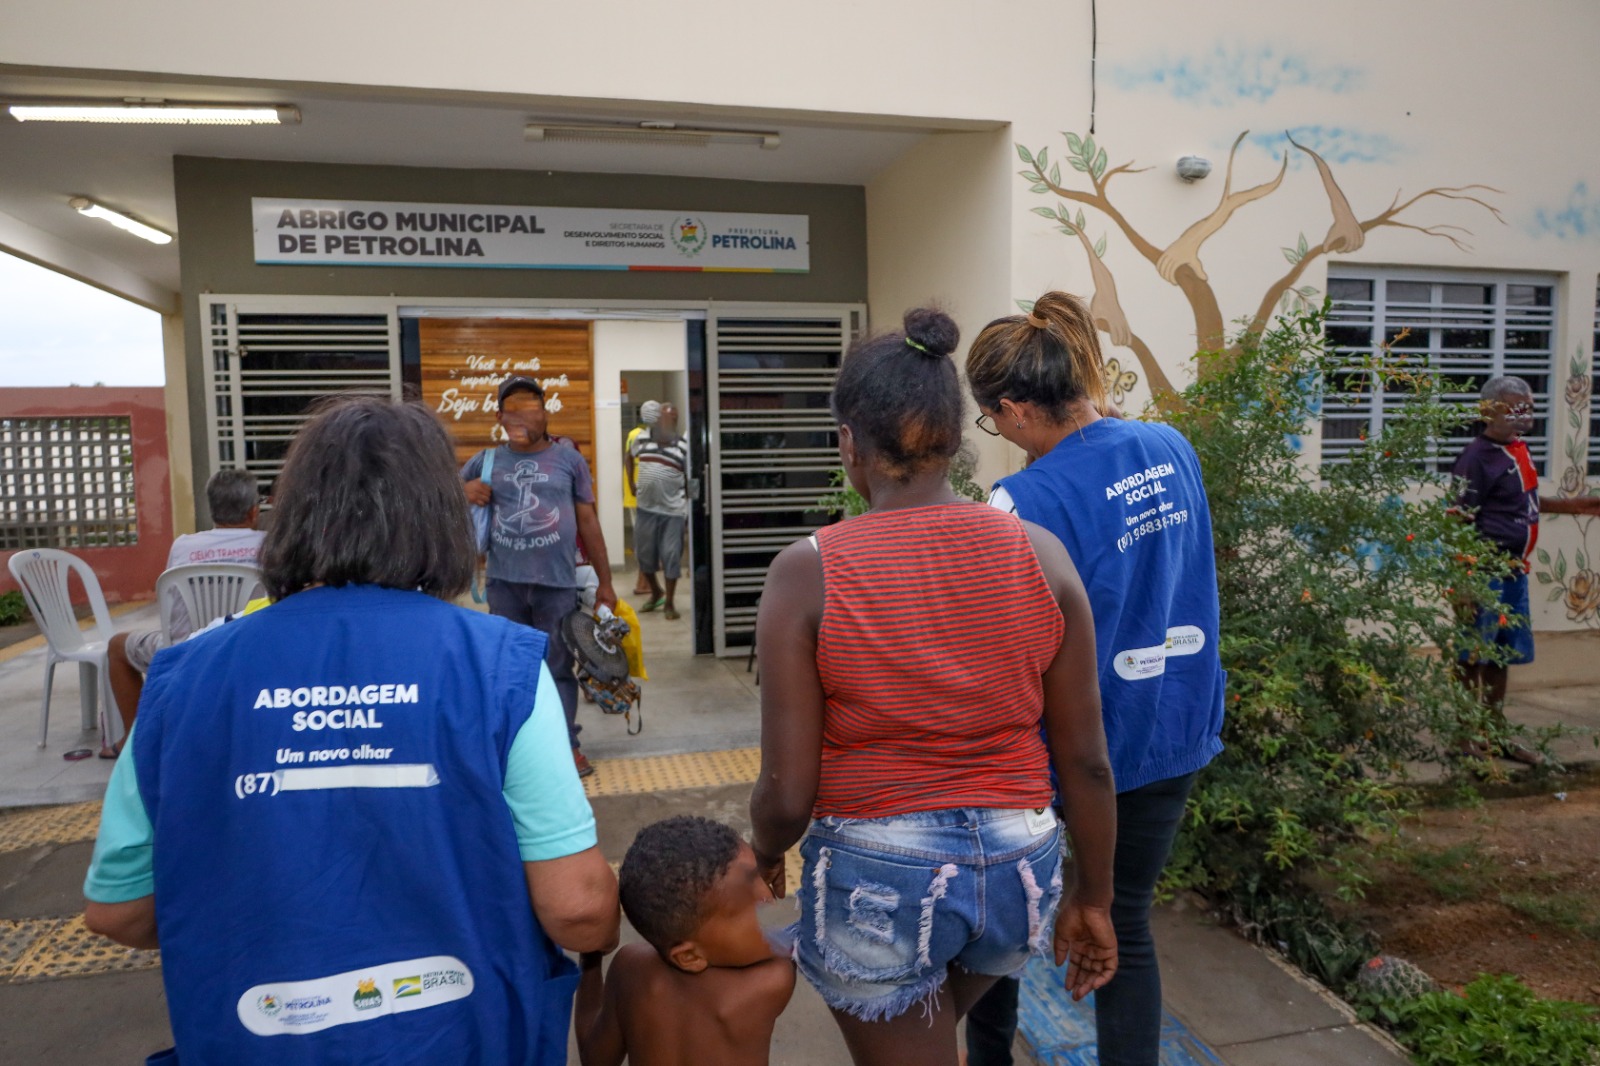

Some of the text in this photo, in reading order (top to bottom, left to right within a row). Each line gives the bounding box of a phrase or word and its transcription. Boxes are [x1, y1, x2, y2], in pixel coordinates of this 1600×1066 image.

[277, 209, 544, 234] ABRIGO MUNICIPAL
[609, 223, 652, 231] SECRETARIA
[278, 234, 485, 256] DE PETROLINA
[564, 231, 665, 240] DESENVOLVIMENTO SOCIAL
[712, 234, 797, 250] PETROLINA
[465, 354, 541, 371] Você é muito
[461, 371, 512, 390] important
[436, 387, 480, 421] Seja
[1105, 462, 1175, 501] ABORDAGEM
[1125, 480, 1167, 505] SOCIAL
[1125, 516, 1139, 527] Um
[1140, 507, 1157, 520] novo
[528, 530, 560, 549] JOHN
[253, 683, 419, 710] ABORDAGEM
[291, 708, 383, 732] SOCIAL
[276, 744, 394, 764] Um novo olhar
[234, 772, 280, 800] (87)
[423, 975, 467, 990] BRASIL
